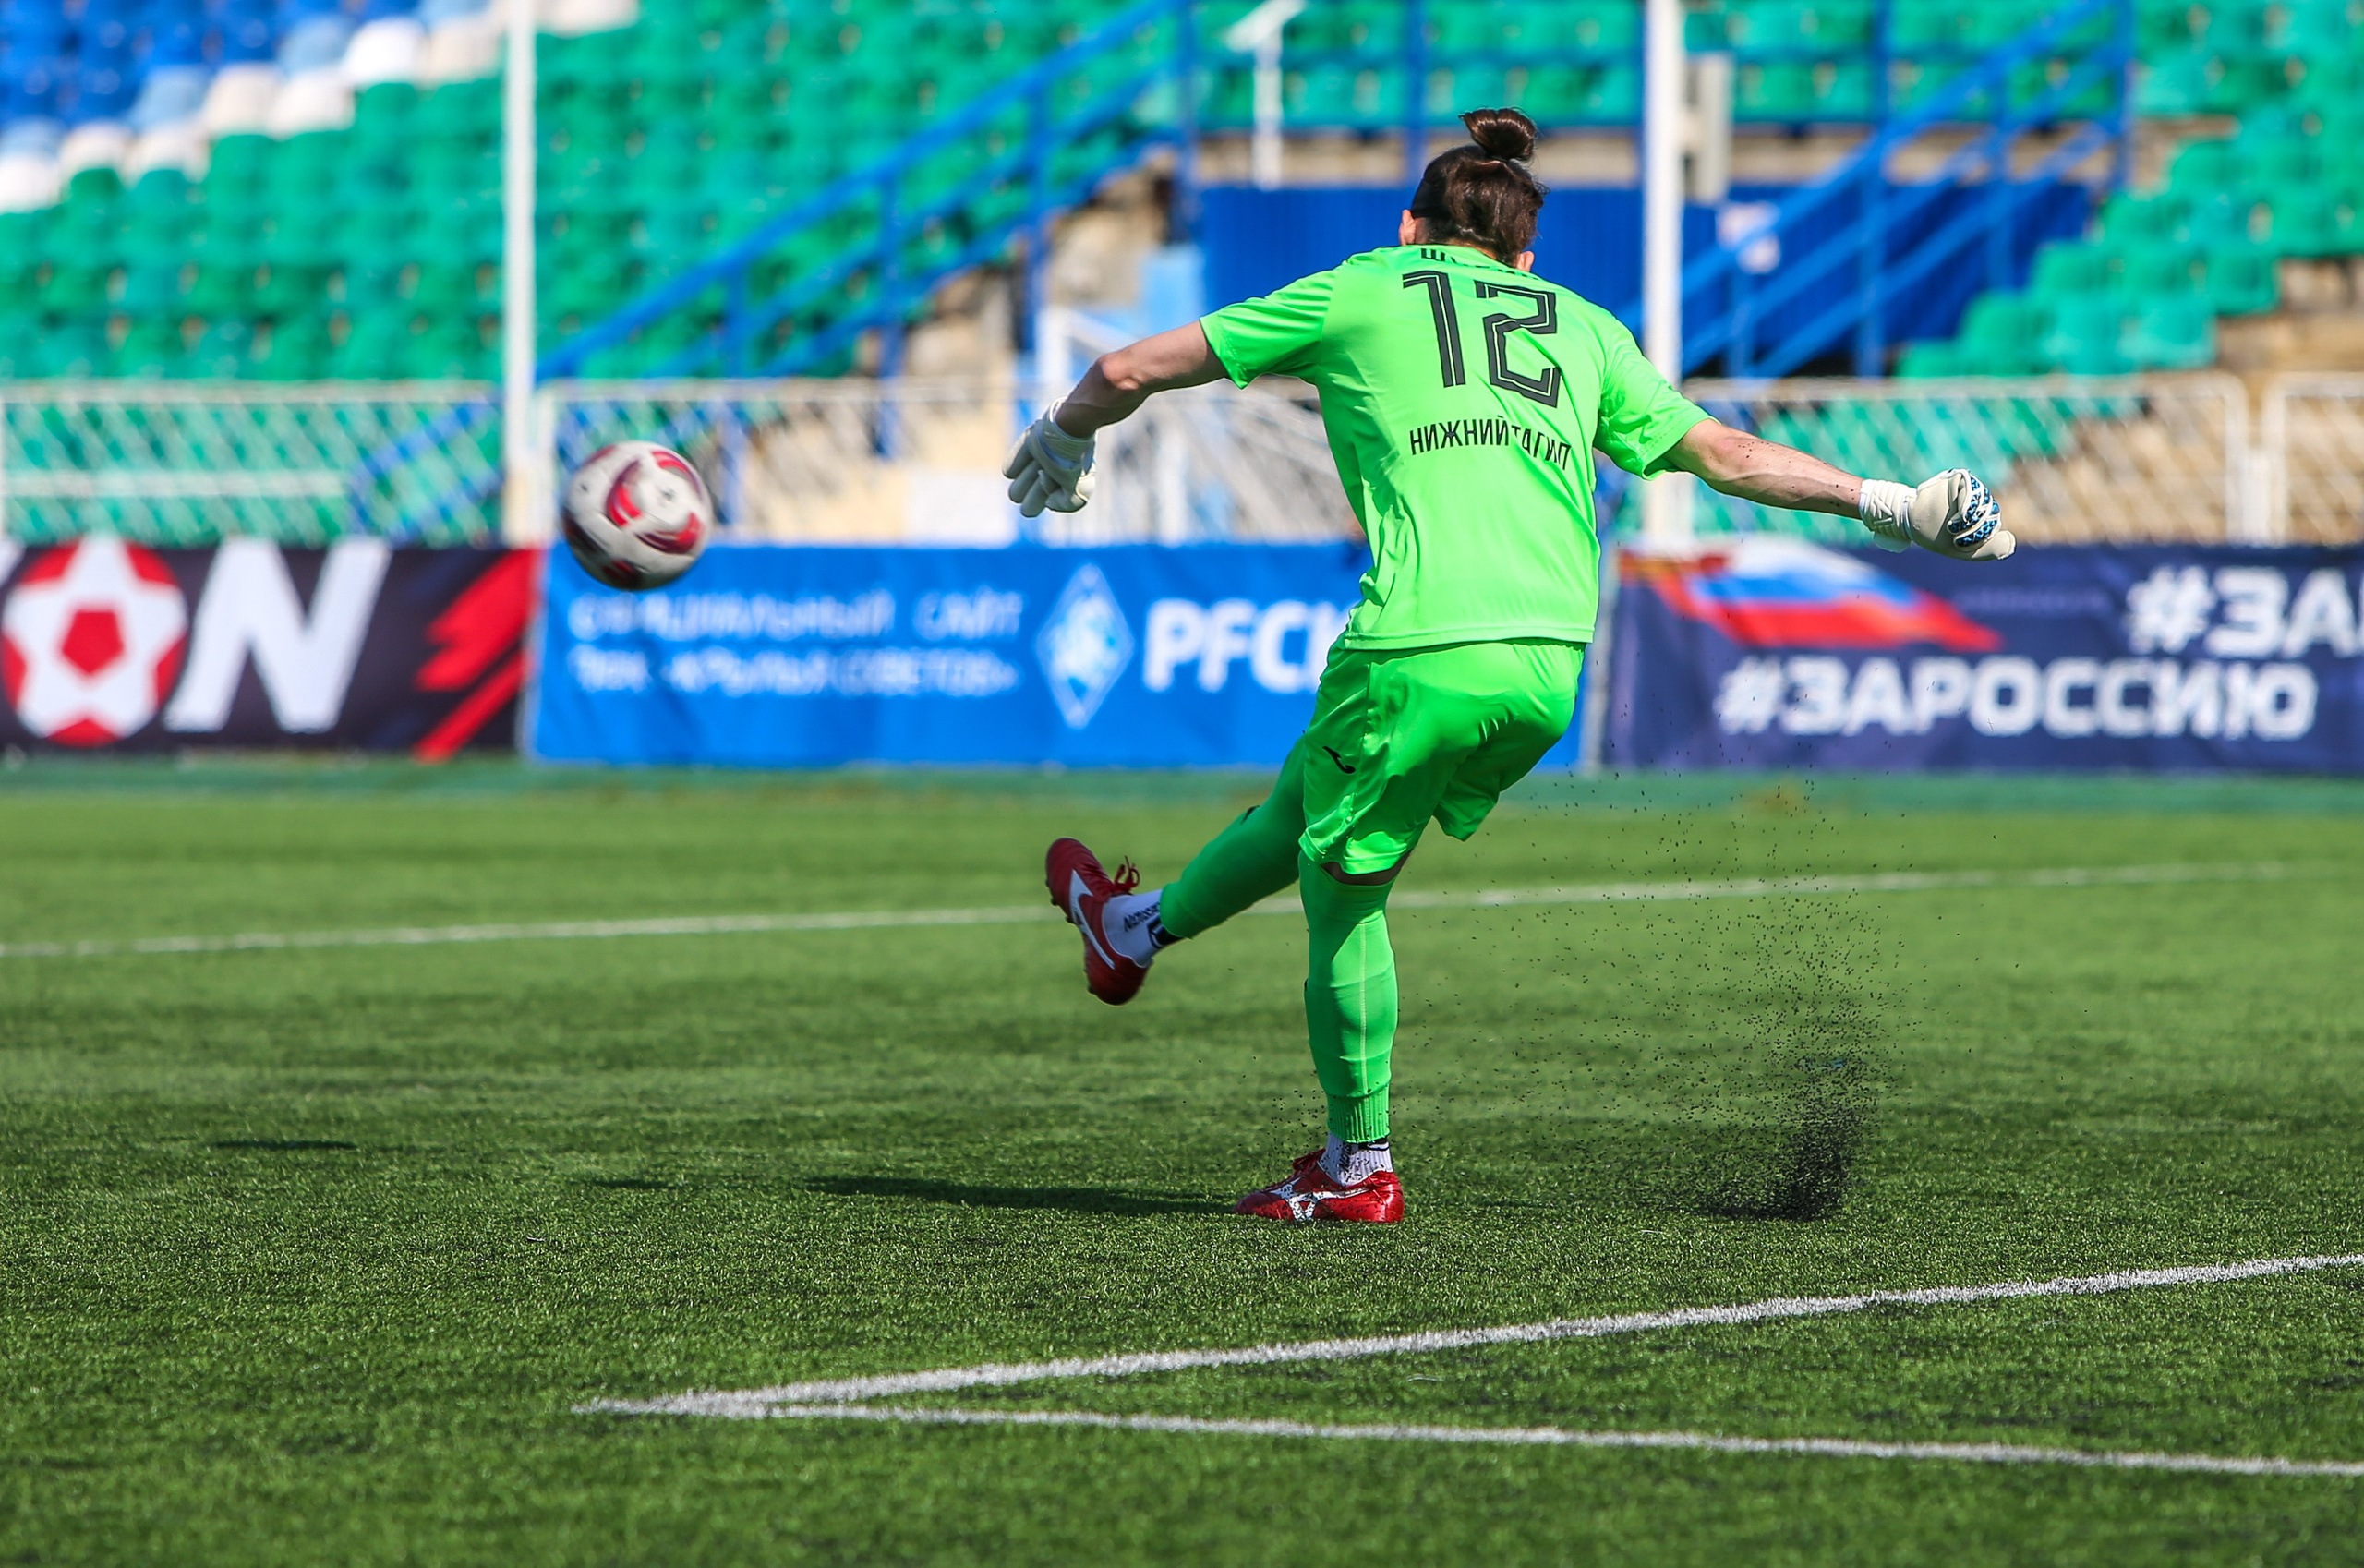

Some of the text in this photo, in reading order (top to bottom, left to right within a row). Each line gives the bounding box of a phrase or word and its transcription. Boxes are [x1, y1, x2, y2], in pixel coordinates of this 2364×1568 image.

[1402, 271, 1562, 408] 12
[1409, 415, 1510, 455] НИЖНИЙ
[2127, 563, 2364, 658] #ЗА
[1716, 655, 2318, 740] #ЗАРОССИЮ
